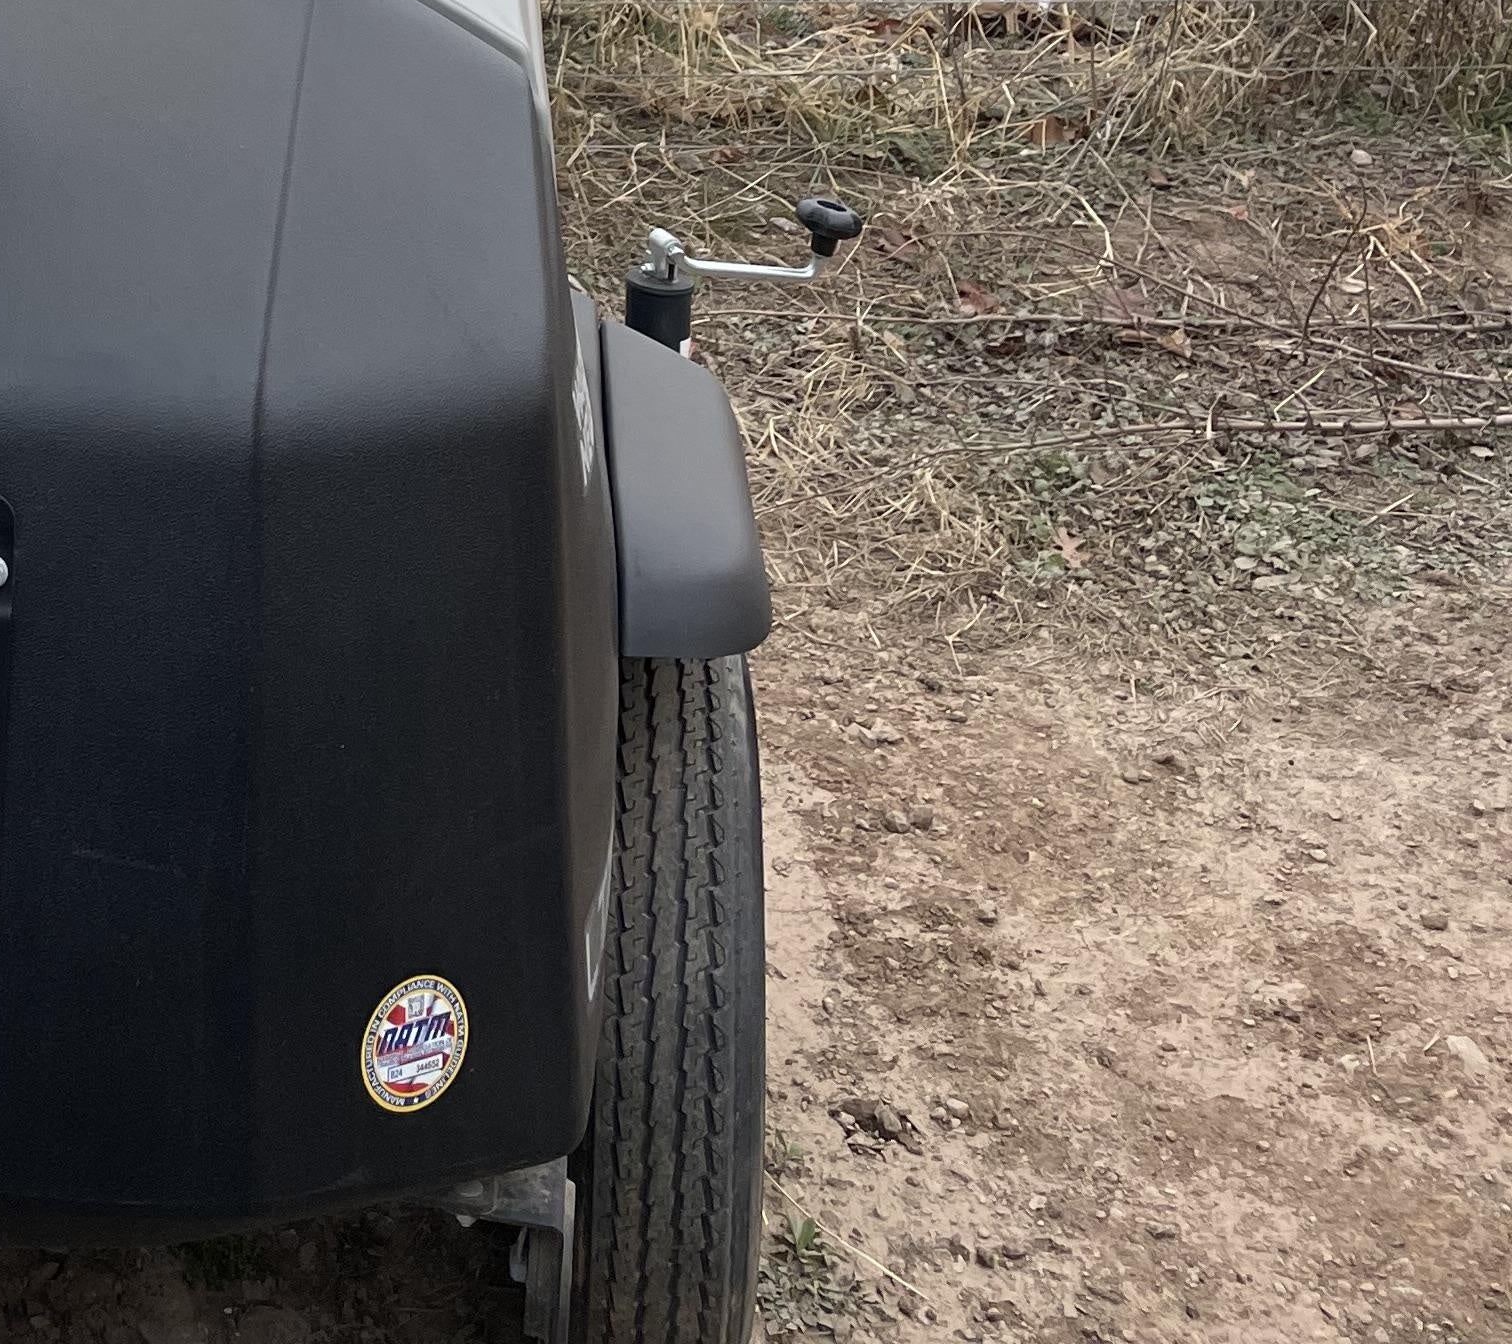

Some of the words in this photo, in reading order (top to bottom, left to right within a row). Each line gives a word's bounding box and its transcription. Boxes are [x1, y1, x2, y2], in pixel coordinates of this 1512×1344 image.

[379, 979, 436, 1019] COMPLIANCE
[436, 983, 458, 1004] WITH
[371, 1020, 380, 1033] IN
[454, 1005, 465, 1036] NATM
[365, 1035, 406, 1106] MANUFACTURED
